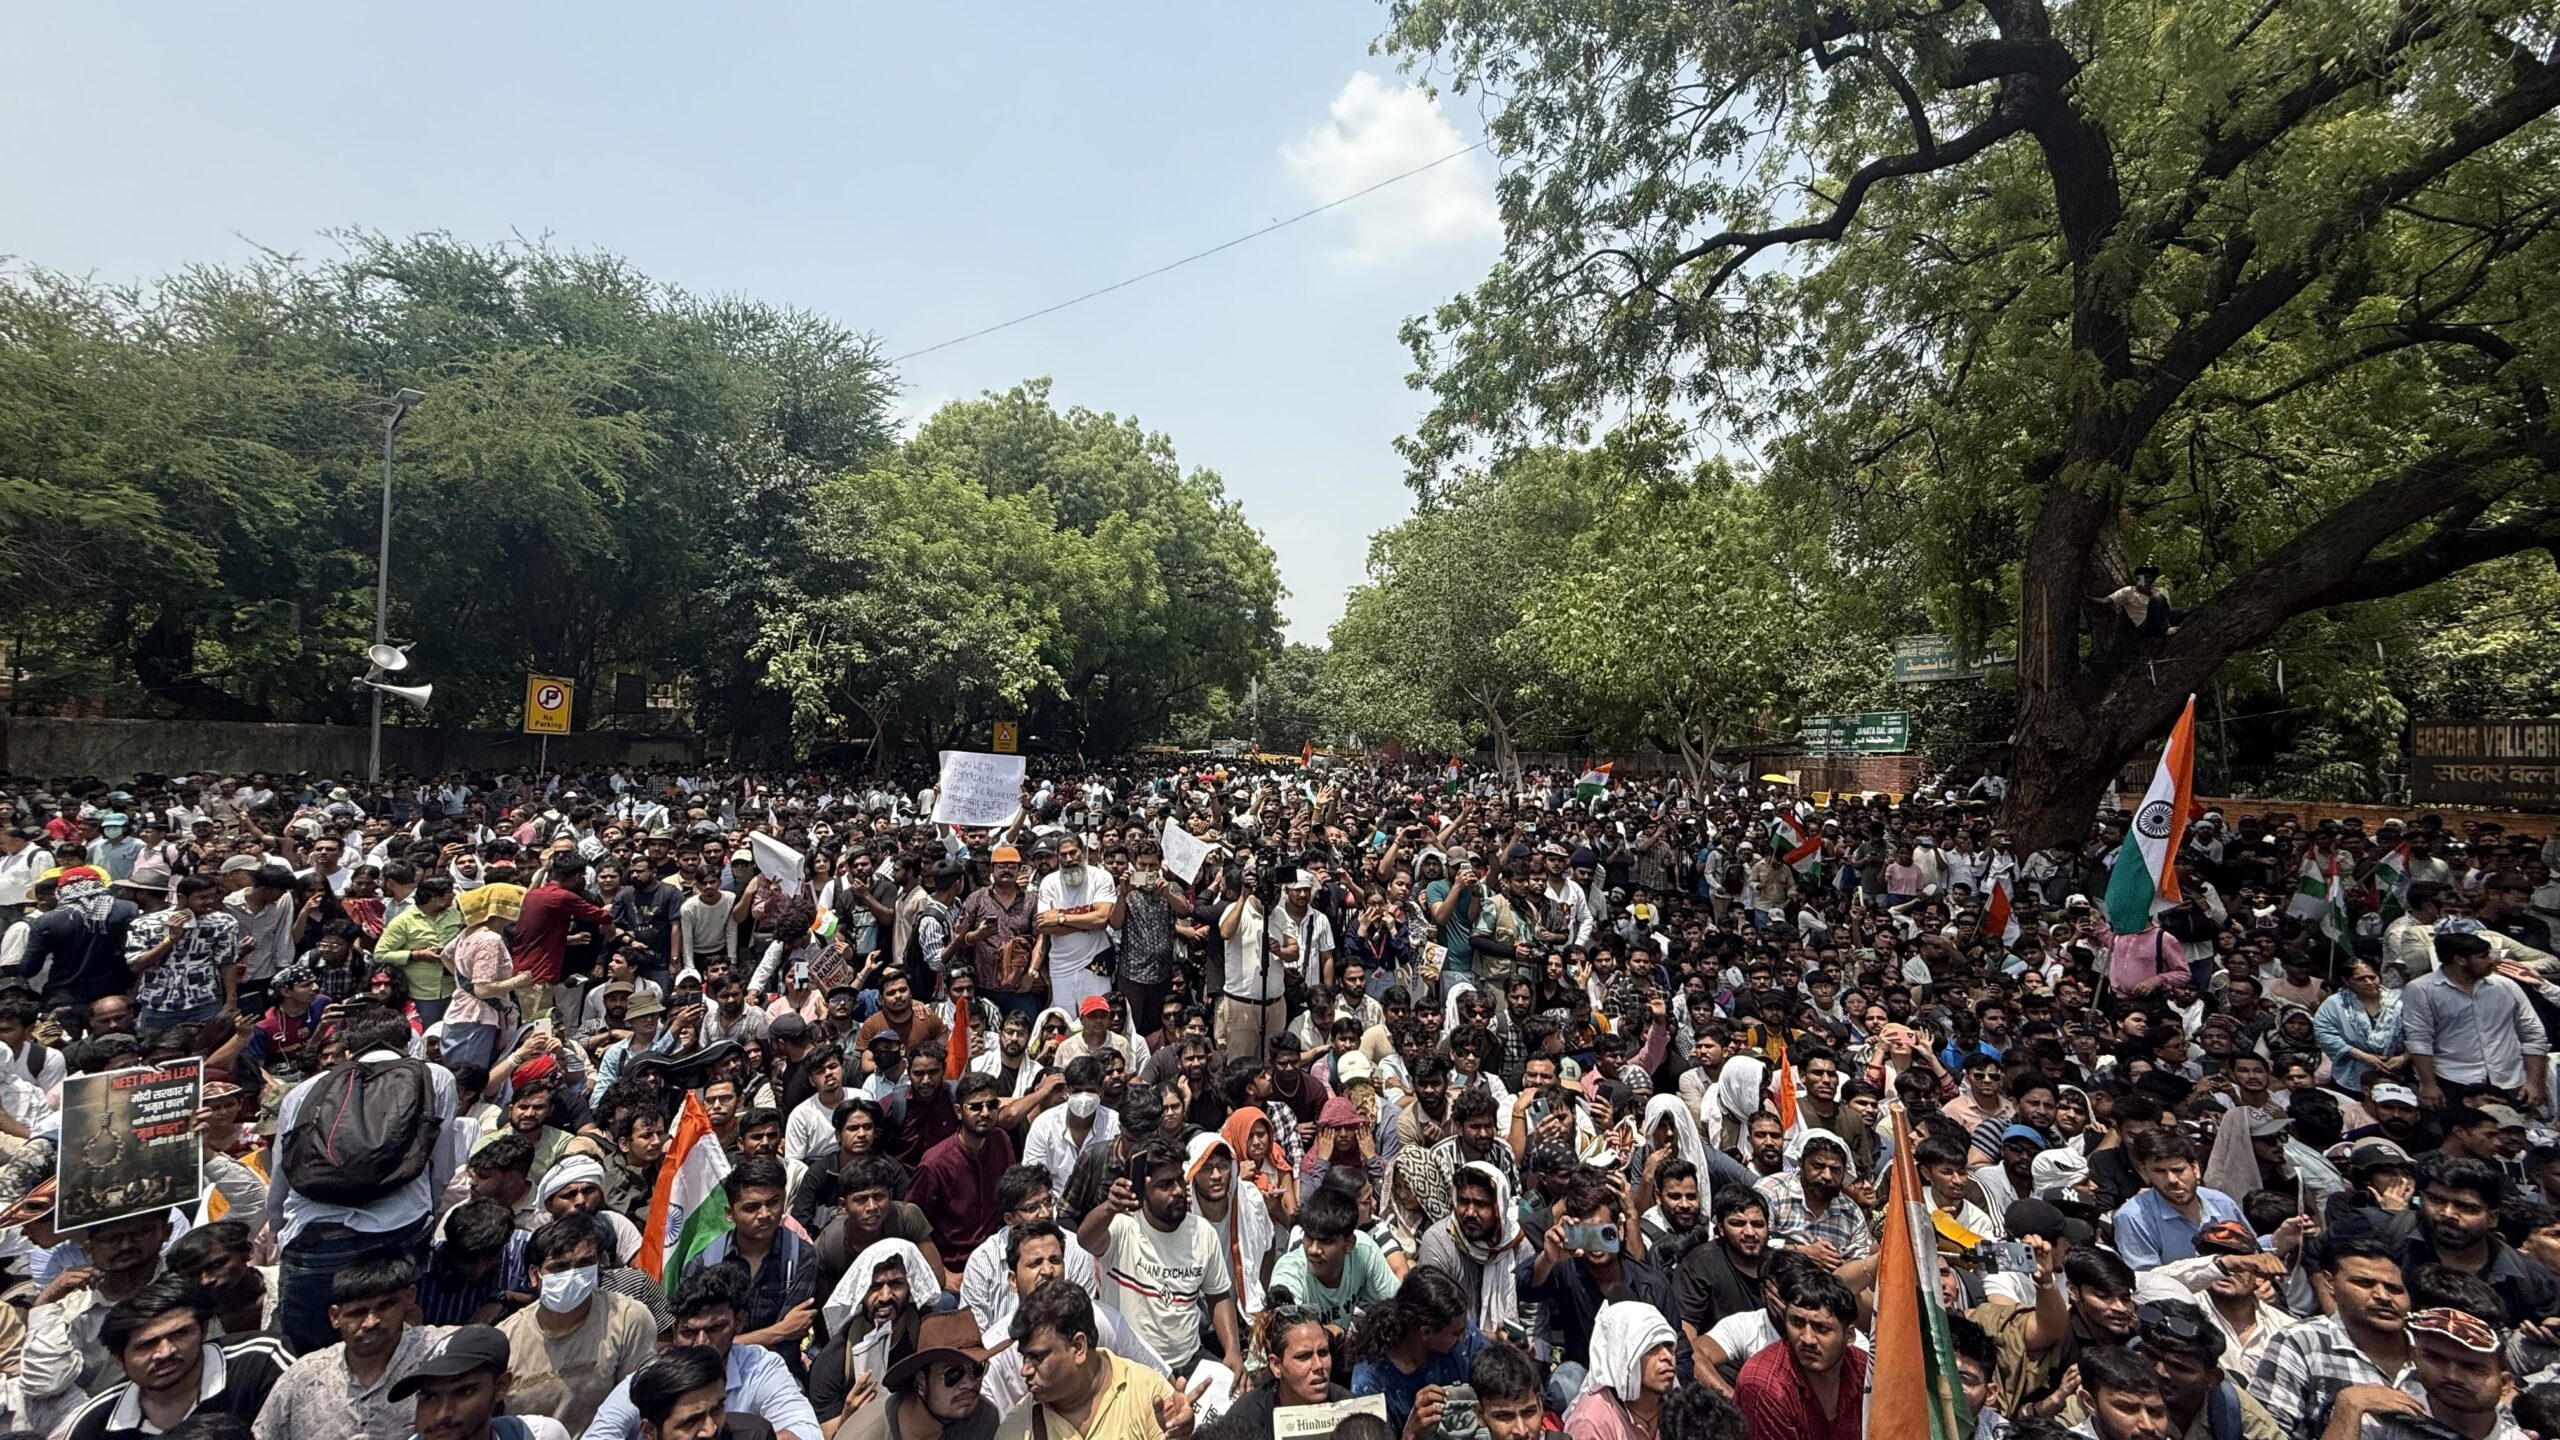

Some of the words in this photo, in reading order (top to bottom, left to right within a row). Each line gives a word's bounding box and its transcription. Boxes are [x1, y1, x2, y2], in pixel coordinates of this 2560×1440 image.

[535, 720, 562, 730] Parking
[1855, 727, 1876, 736] JANATA
[1876, 726, 1887, 735] DAL
[2415, 726, 2478, 756] SARDAR
[2483, 725, 2560, 757] VALLABH
[973, 760, 994, 772] WITH
[2432, 764, 2505, 783] सरदार
[2509, 764, 2560, 785] वल्ल
[2500, 791, 2546, 801] JANTAR
[812, 946, 836, 973] ARMENDR
[817, 952, 841, 979] RADHA
[112, 1075, 137, 1090] NEET
[140, 1069, 172, 1084] PAPER
[173, 1066, 199, 1080] LEAK
[131, 1089, 152, 1102] मोदी
[153, 1086, 183, 1099] सरकार
[184, 1082, 195, 1094] में
[2061, 1187, 2080, 1202] NY
[1296, 1416, 1343, 1432] Hindusta
